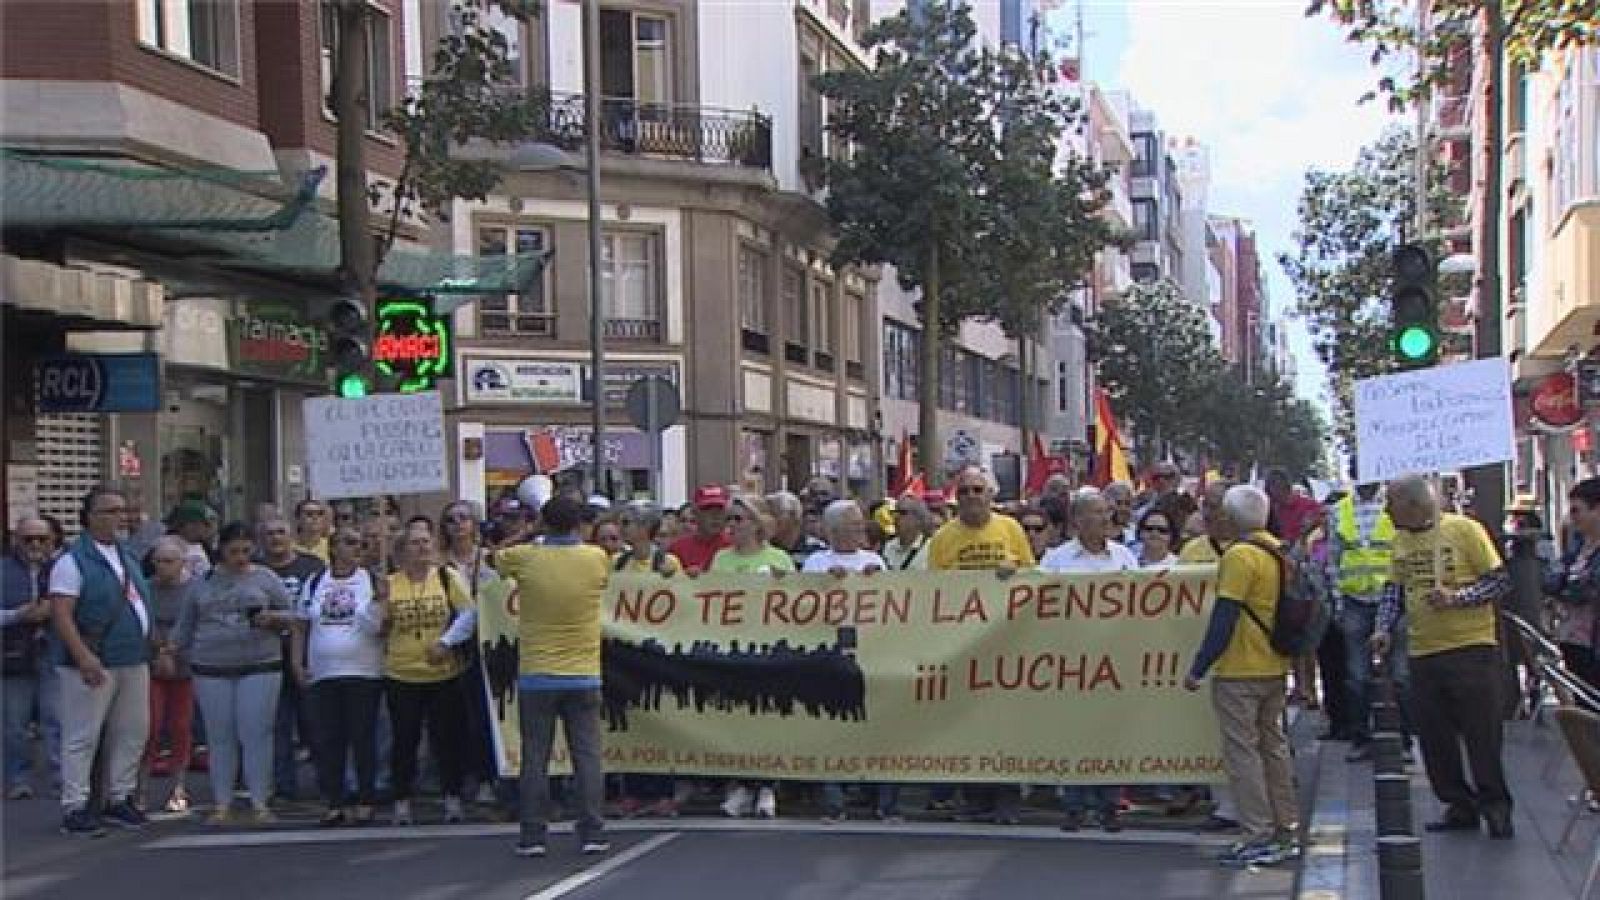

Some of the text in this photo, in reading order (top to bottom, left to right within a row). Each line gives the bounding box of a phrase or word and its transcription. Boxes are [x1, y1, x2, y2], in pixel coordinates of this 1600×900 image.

[614, 569, 1206, 626] NO TE ROBEN LA PENSIÓN
[969, 653, 1121, 691] LUCHA
[1141, 651, 1179, 688] !!!
[632, 748, 669, 763] POR
[676, 751, 699, 765] LA
[705, 752, 788, 770] DEFENSA
[792, 755, 816, 771] DE
[824, 755, 861, 772] LAS
[864, 755, 970, 773] PENSIONES
[979, 750, 1070, 776] PÚBLICAS
[1076, 756, 1133, 774] GRAN
[1139, 755, 1225, 774] CANARIA
